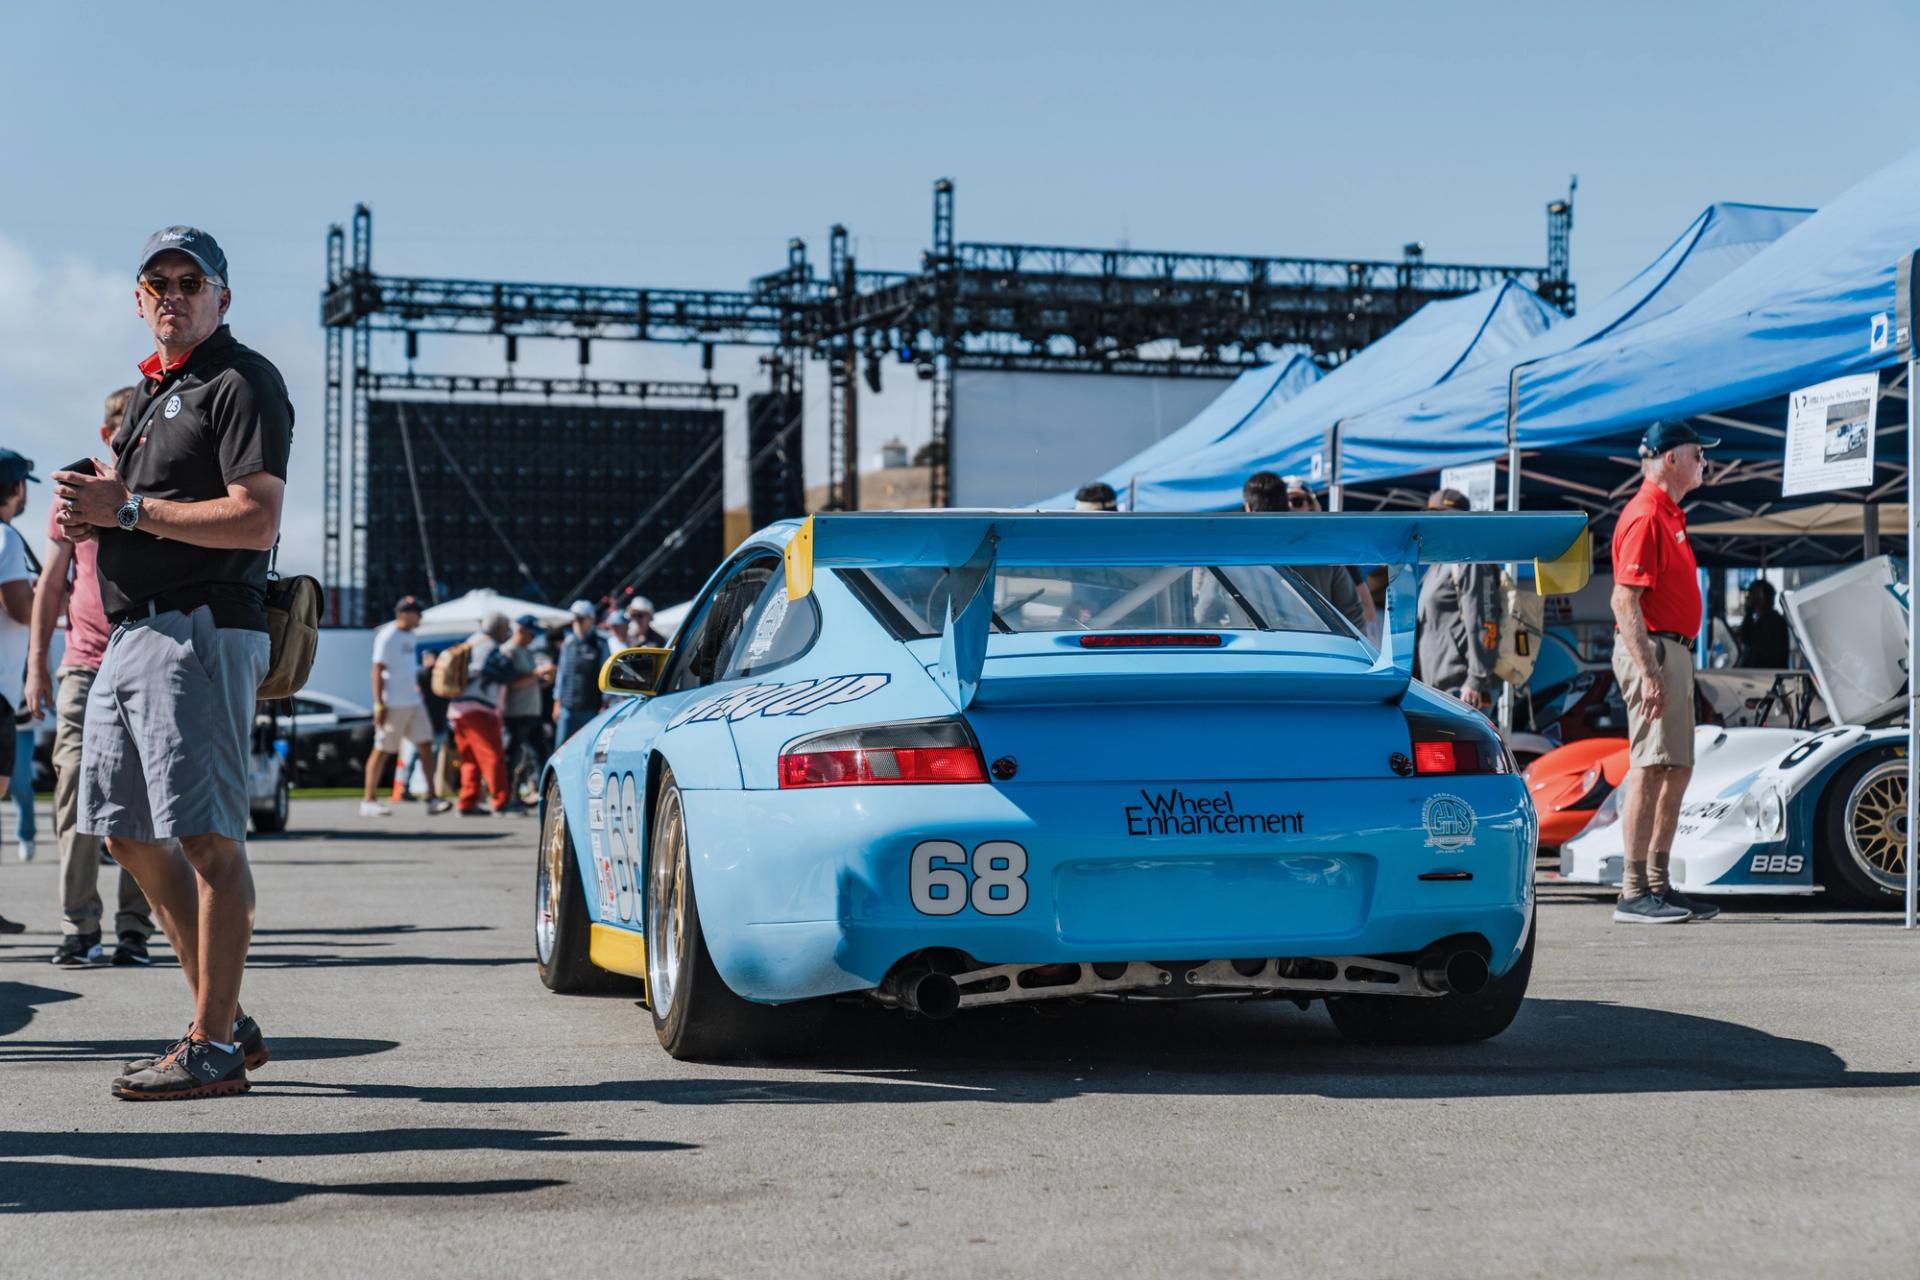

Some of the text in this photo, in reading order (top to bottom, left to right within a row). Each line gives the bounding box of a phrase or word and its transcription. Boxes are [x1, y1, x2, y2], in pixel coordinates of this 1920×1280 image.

[166, 399, 180, 413] 23
[1141, 788, 1235, 815] Wheel
[1125, 806, 1304, 836] Enhancement
[606, 771, 642, 927] 68
[909, 839, 1029, 917] 68
[1750, 855, 1804, 873] BBS
